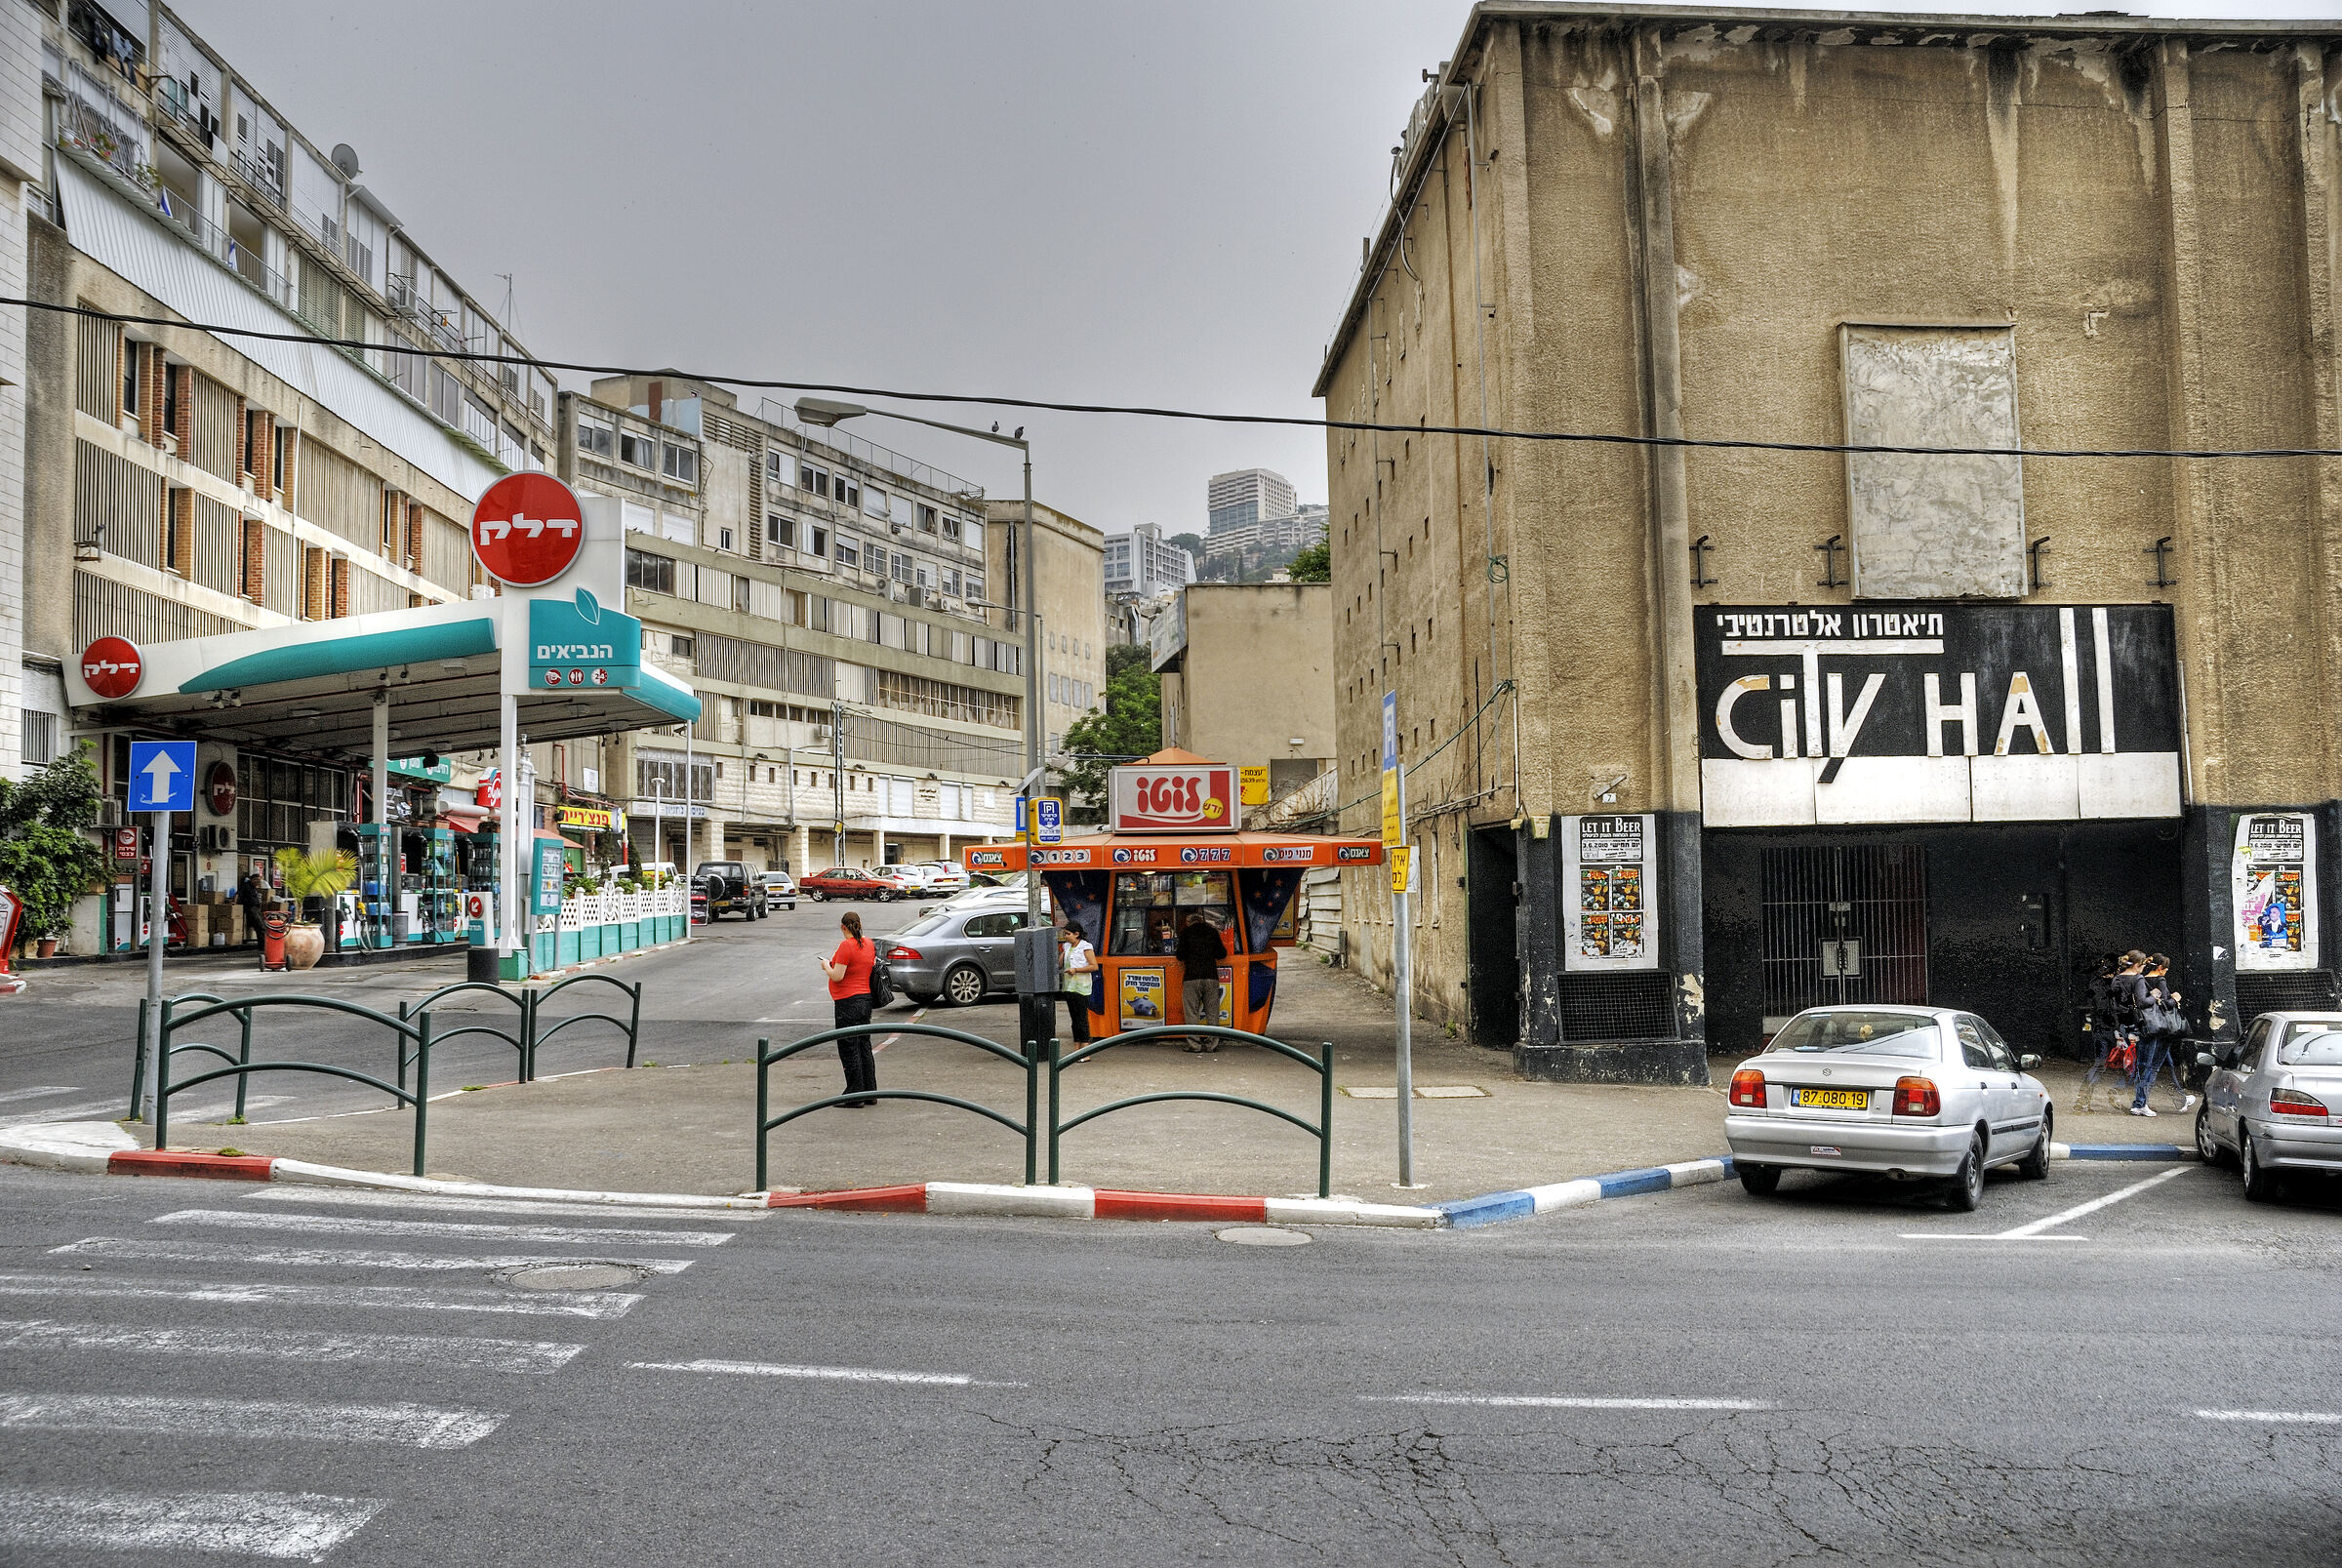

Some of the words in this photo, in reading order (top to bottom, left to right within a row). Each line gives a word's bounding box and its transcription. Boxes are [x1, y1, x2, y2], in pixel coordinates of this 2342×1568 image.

[479, 512, 578, 545] דלק
[1716, 610, 1841, 637] אלטרנטיבי
[1852, 613, 1944, 636] תיאטרון
[537, 644, 613, 660] הנביאים
[84, 660, 139, 678] דלק
[1136, 776, 1202, 813] לוטו
[1203, 803, 1222, 814] חדש
[1582, 822, 1597, 832] LET
[2250, 824, 2264, 833] LET
[1133, 849, 1155, 863] לוטו
[1199, 848, 1231, 861] 777
[1279, 850, 1293, 860] פיס
[1295, 849, 1312, 859] מנוי
